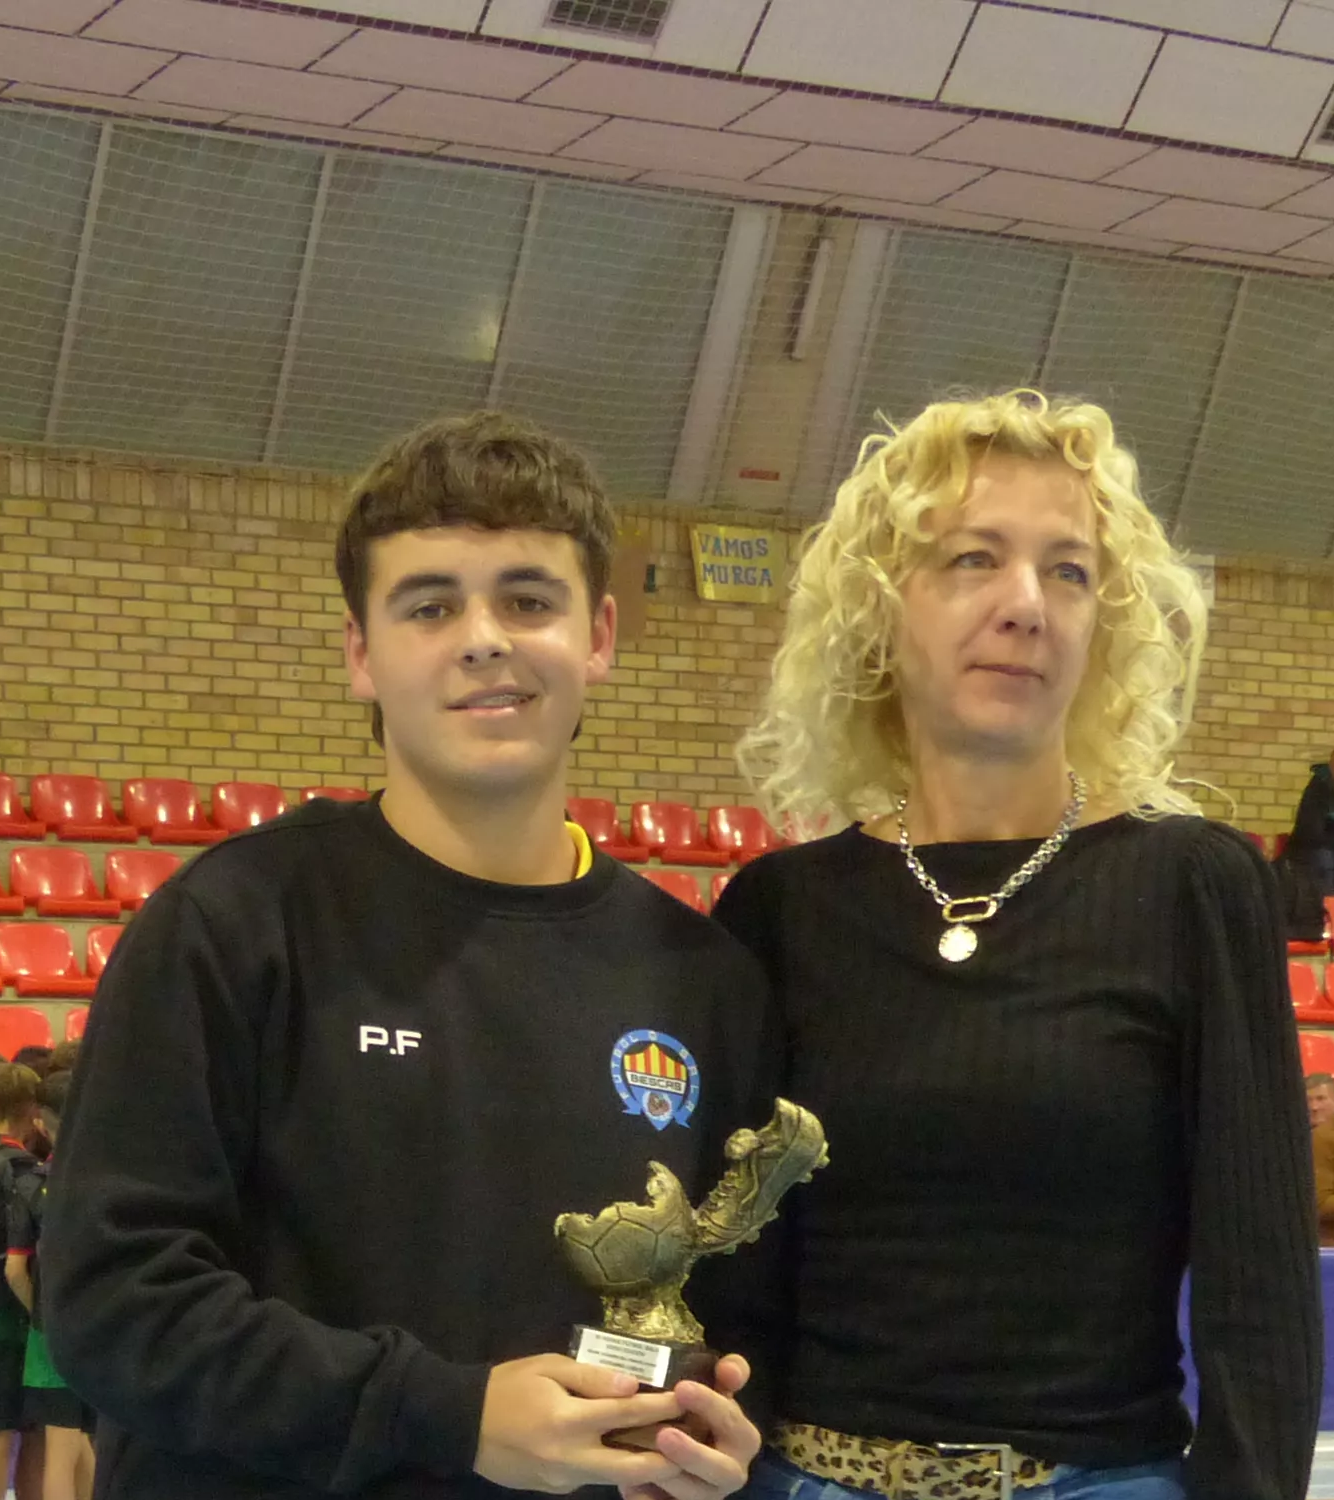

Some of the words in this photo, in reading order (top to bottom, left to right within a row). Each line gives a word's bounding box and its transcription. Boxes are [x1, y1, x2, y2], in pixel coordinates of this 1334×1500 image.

[698, 533, 768, 559] VAMOS
[702, 562, 774, 588] MURGA
[360, 1025, 422, 1055] P.F
